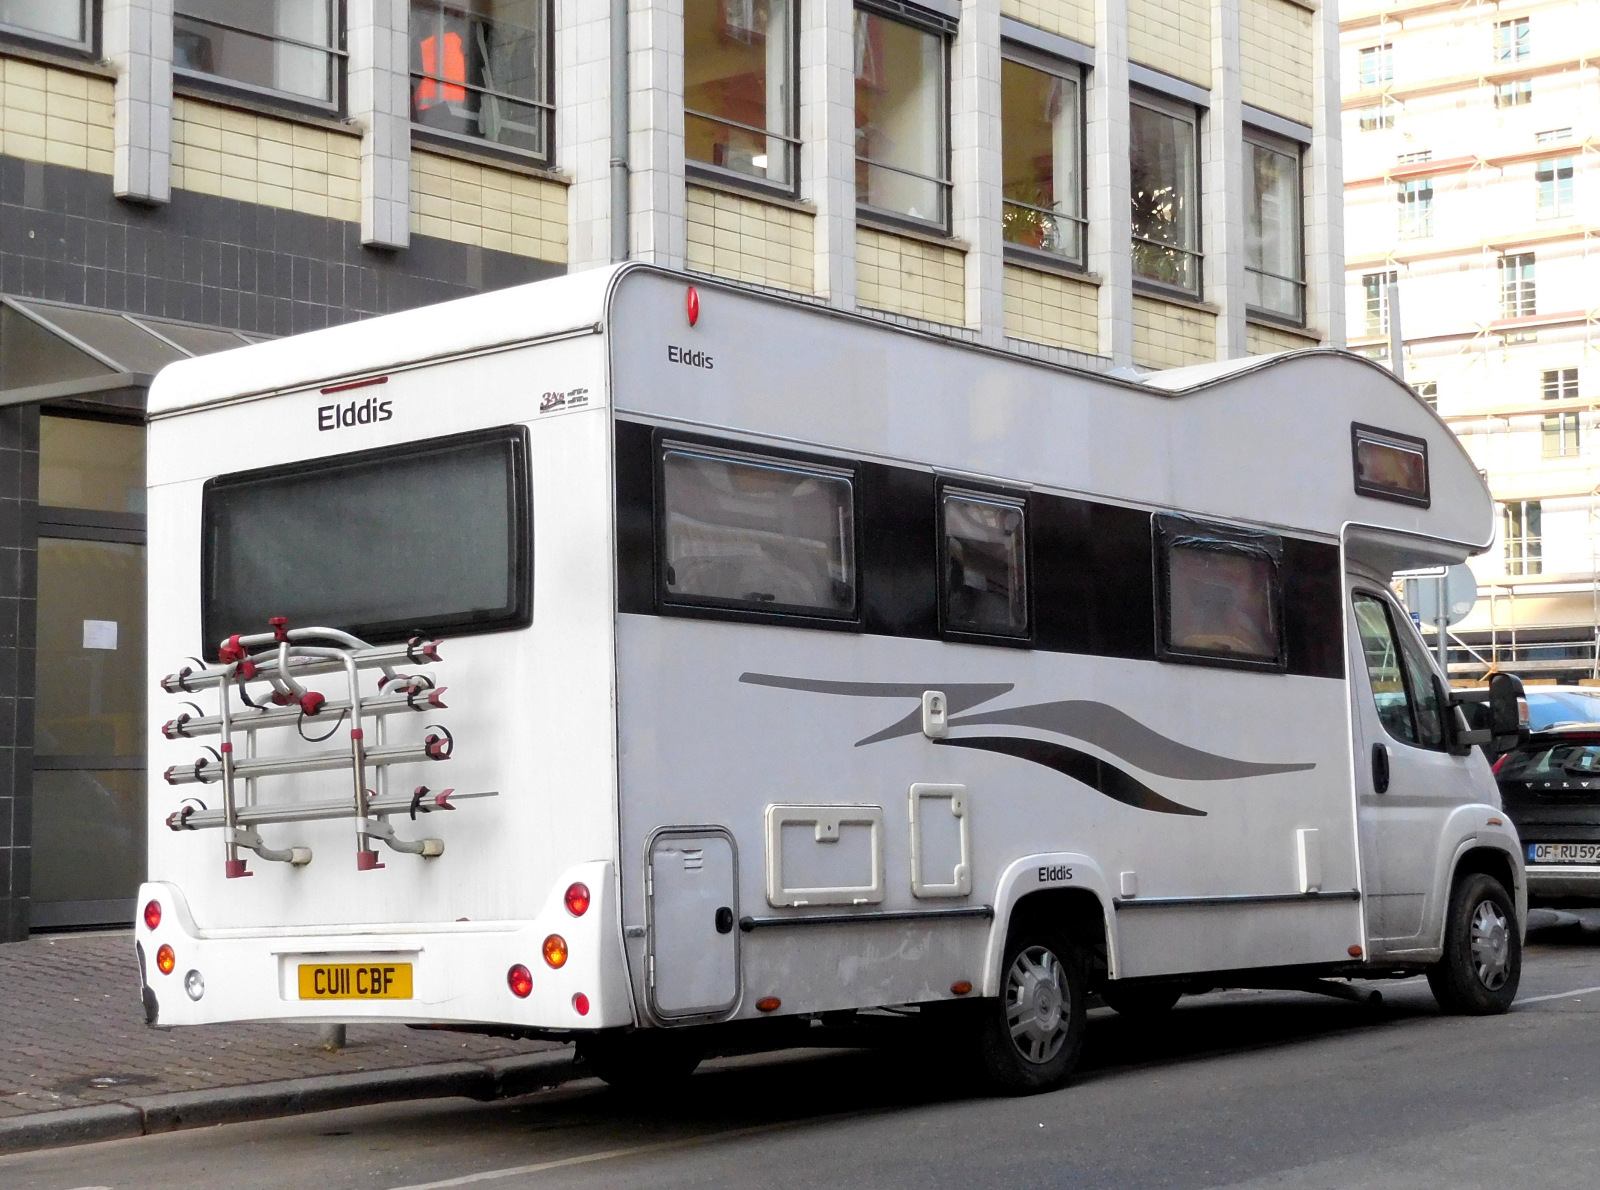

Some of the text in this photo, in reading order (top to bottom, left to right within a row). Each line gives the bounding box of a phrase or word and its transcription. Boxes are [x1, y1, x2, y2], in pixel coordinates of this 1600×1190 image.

[668, 345, 714, 370] Elddis
[318, 397, 393, 432] Elddis
[1536, 845, 1552, 858] OF
[1038, 865, 1073, 882] Elddis
[356, 967, 395, 995] CBF
